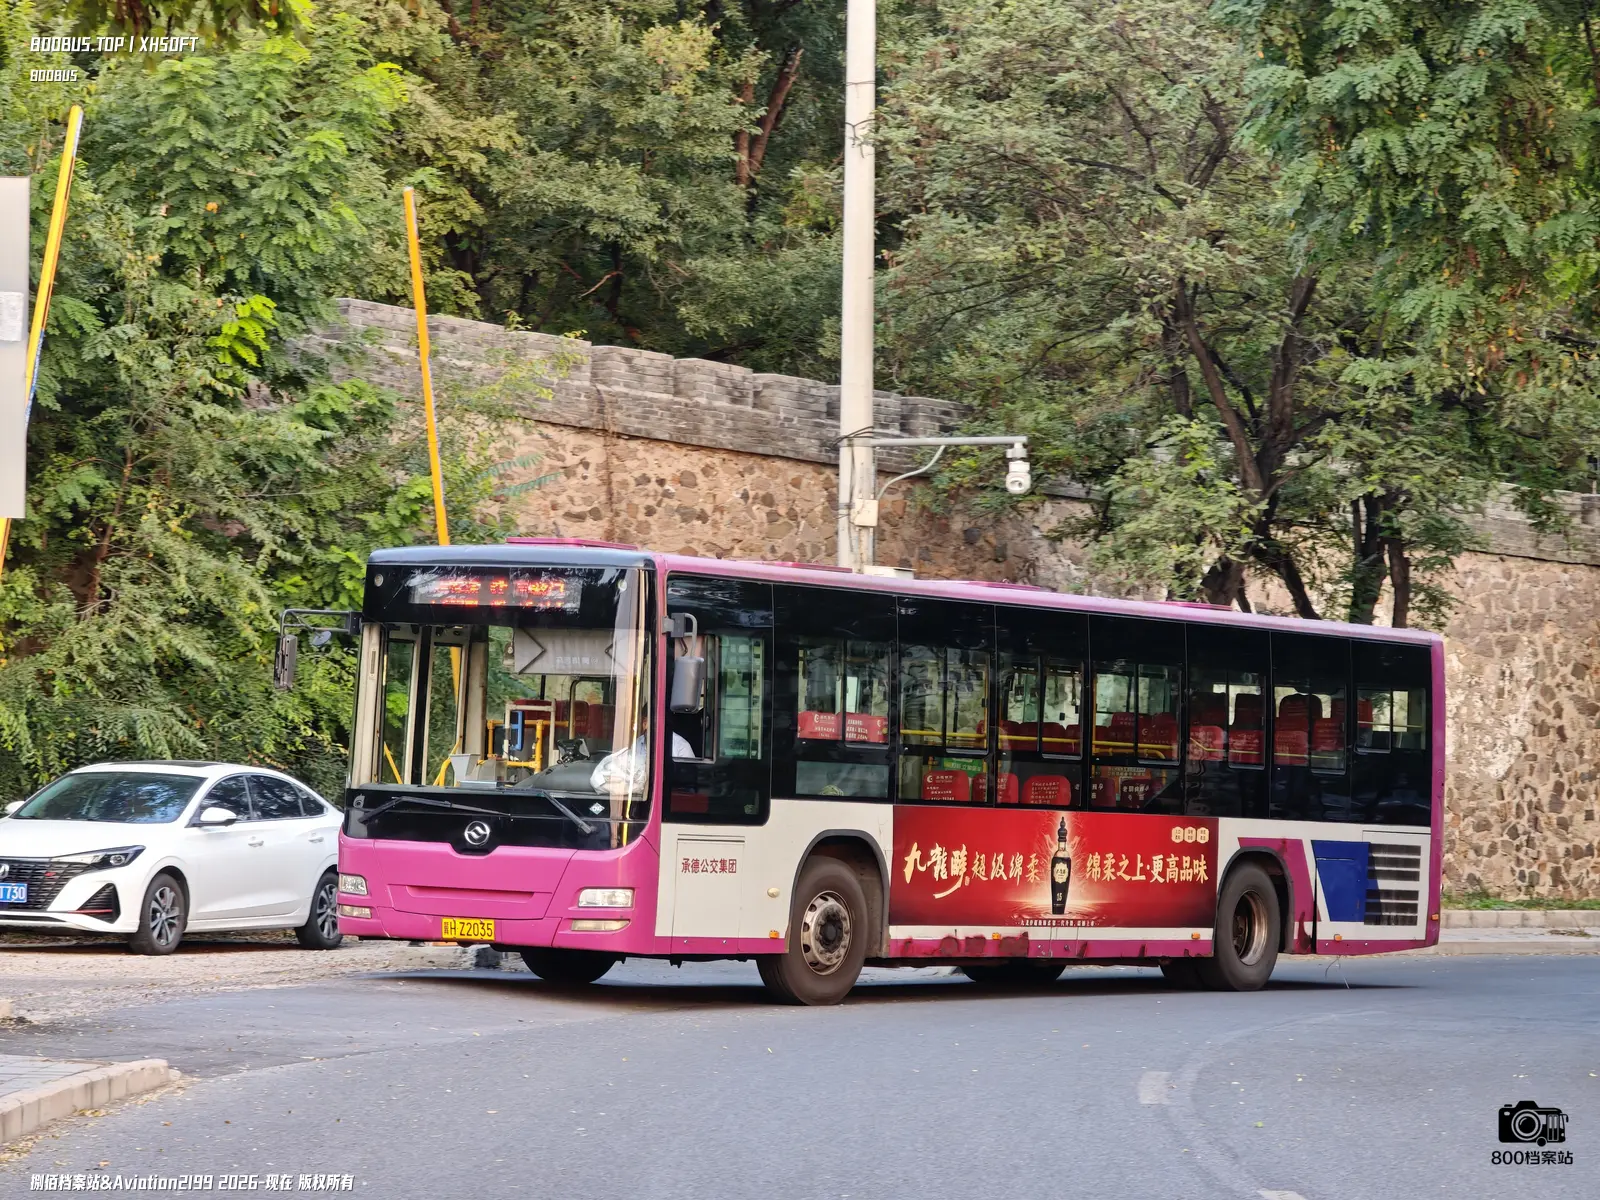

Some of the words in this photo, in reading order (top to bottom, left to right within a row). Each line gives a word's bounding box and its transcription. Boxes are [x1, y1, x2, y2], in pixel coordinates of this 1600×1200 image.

[681, 858, 737, 874] 承德公交集团
[972, 851, 1041, 886] 超级绵柔
